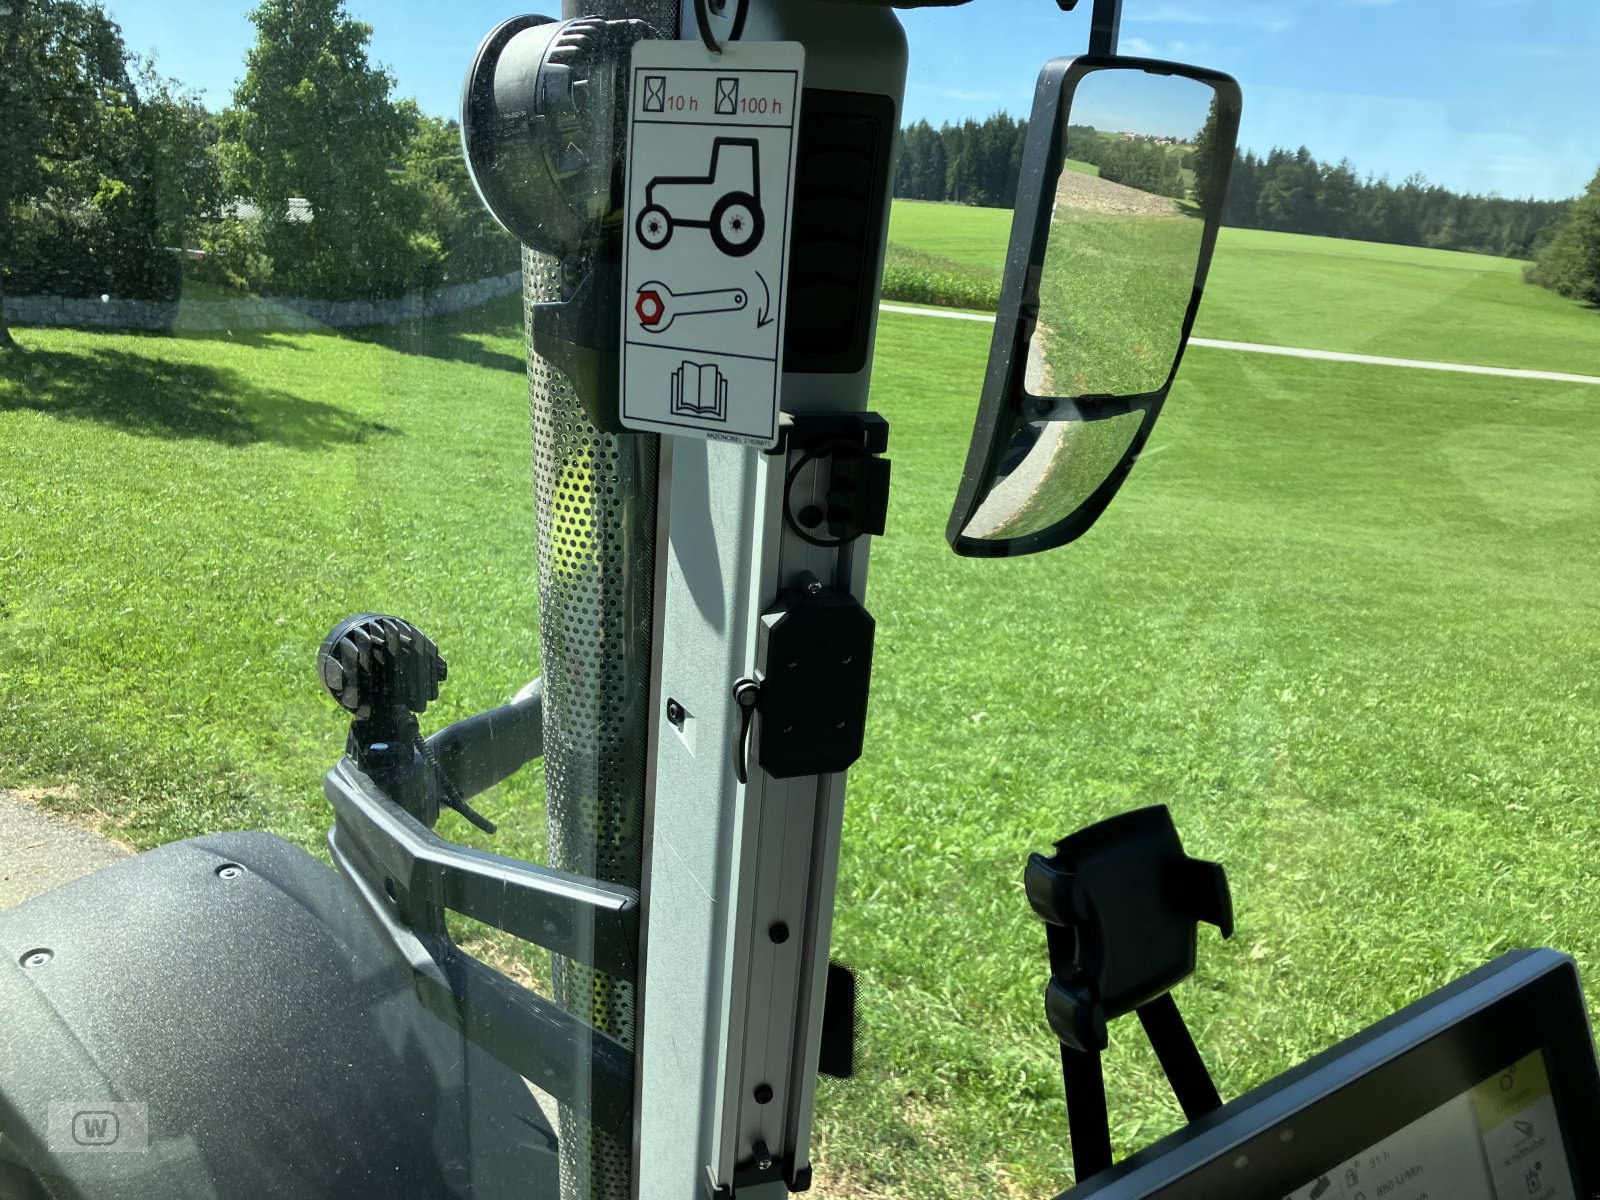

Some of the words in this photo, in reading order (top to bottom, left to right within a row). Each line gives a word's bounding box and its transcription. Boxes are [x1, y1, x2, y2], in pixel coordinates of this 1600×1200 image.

[668, 95, 684, 111] 10
[689, 96, 698, 111] h
[740, 98, 768, 114] 100
[773, 98, 782, 114] h
